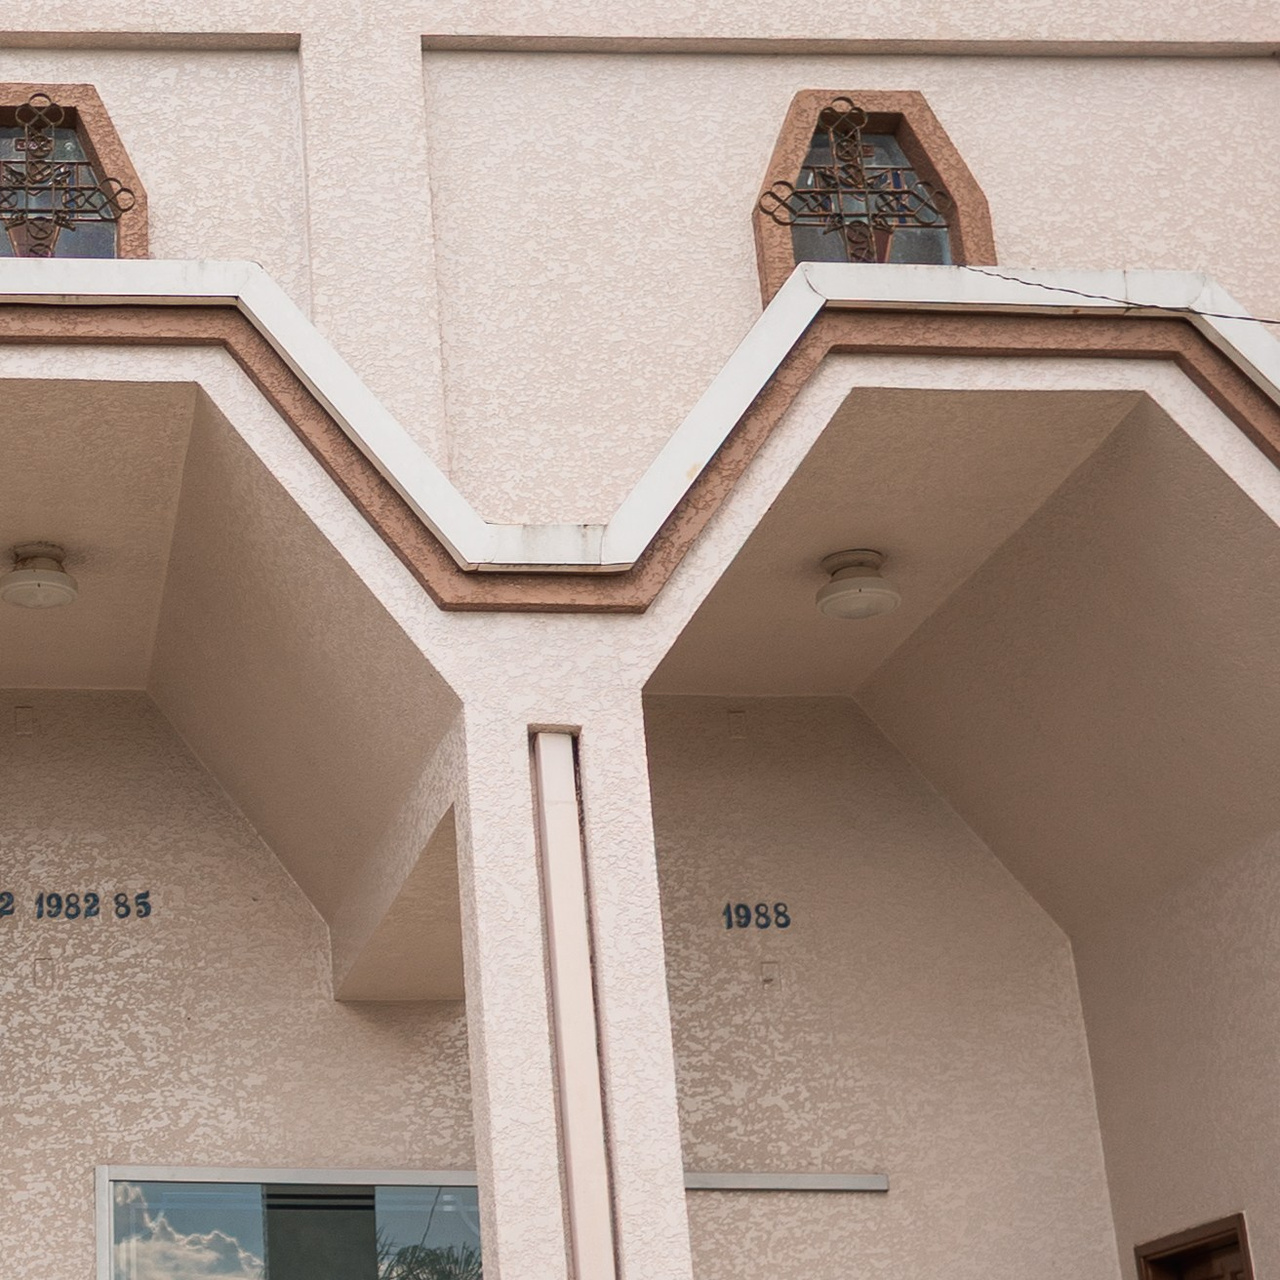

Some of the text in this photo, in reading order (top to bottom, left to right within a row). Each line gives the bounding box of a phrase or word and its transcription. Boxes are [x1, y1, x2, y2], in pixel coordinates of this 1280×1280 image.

[34, 891, 100, 919] 1982
[114, 890, 152, 919] 85
[722, 902, 791, 929] 1988
